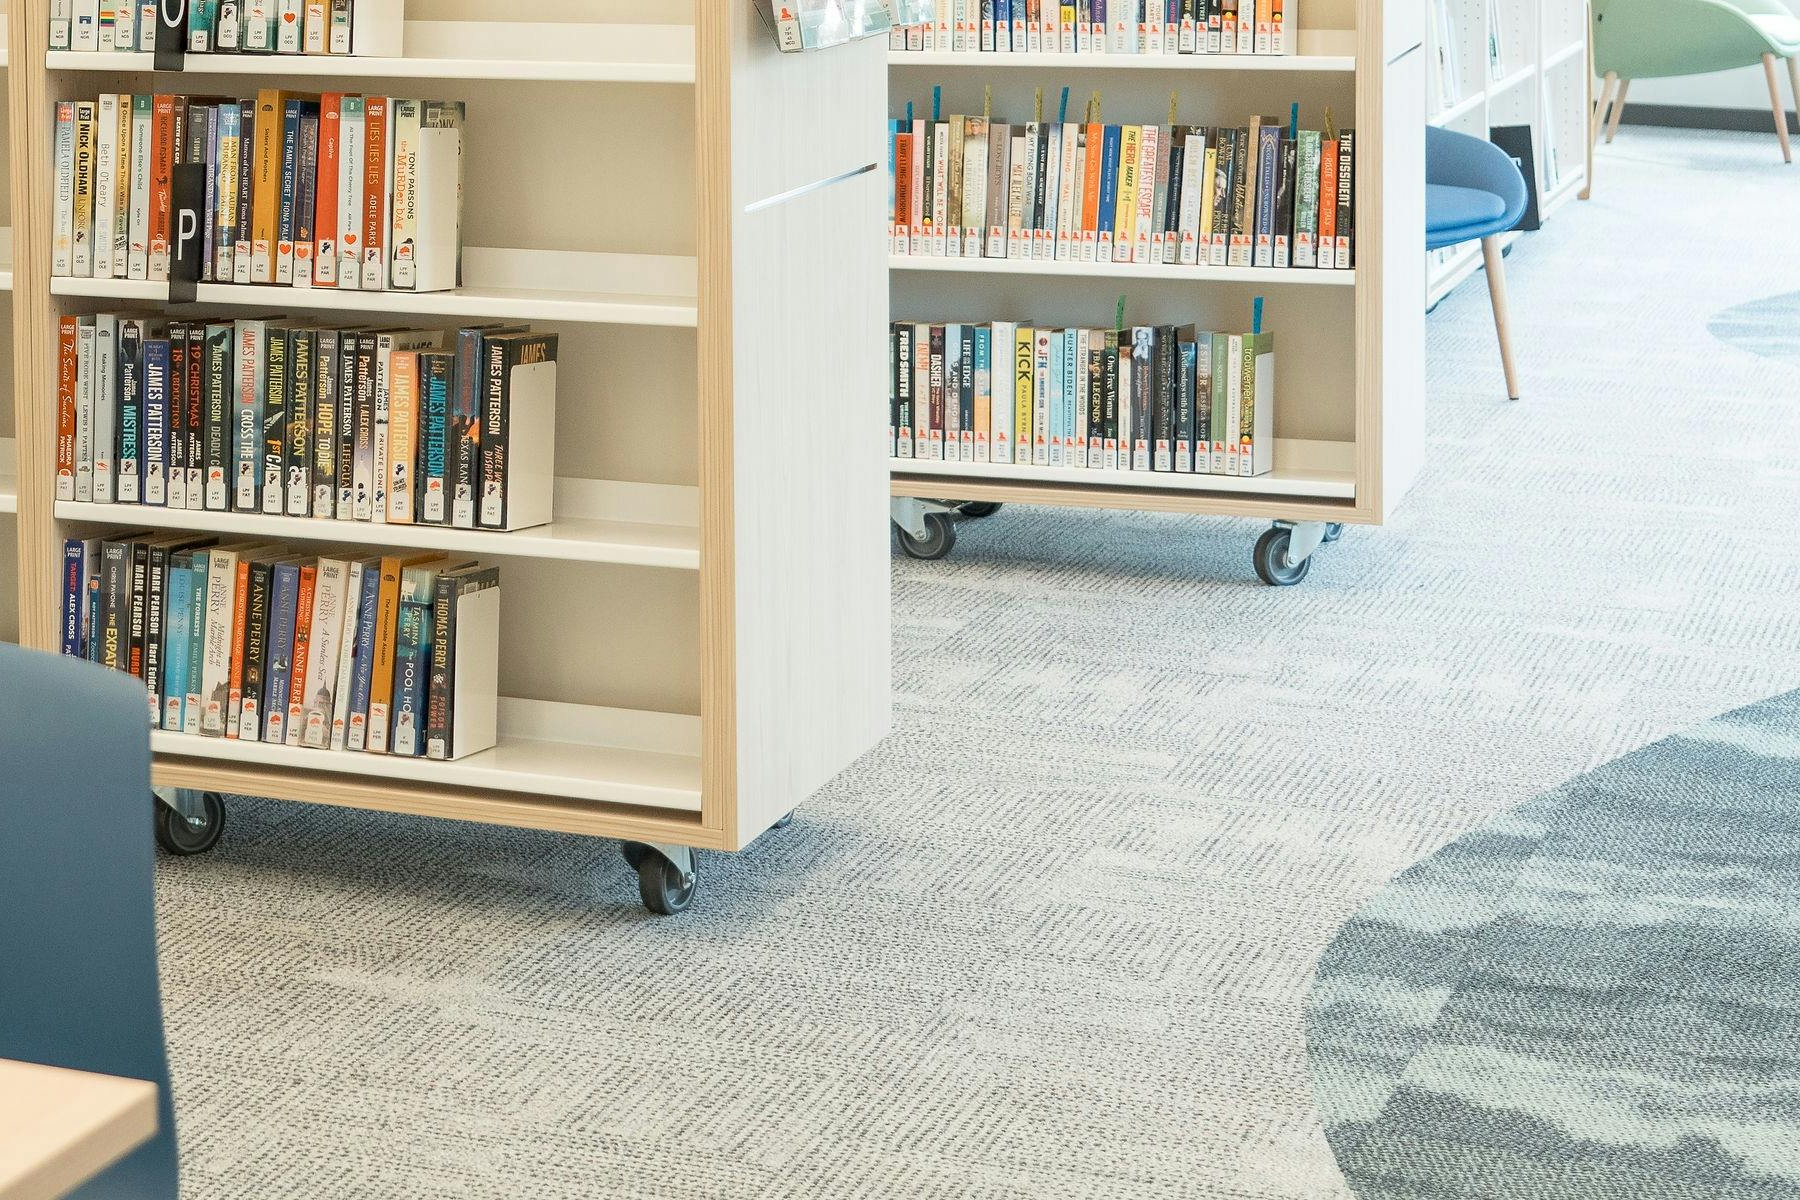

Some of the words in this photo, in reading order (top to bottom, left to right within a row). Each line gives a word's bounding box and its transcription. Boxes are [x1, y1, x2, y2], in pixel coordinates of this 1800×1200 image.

[78, 121, 91, 148] NICK
[77, 150, 90, 196] OLDHAM
[177, 208, 197, 261] P
[150, 363, 161, 396] JAMES
[318, 354, 330, 400] Patterson
[488, 345, 501, 376] JAMES
[1017, 340, 1031, 382] KICK
[317, 402, 334, 436] HOPE
[487, 378, 500, 435] PATTERSON
[147, 398, 161, 464] PATTERSON
[250, 579, 263, 612] ANNE
[248, 612, 261, 664] PERRY
[435, 597, 447, 640] THOMAS
[434, 639, 446, 670] PERRY
